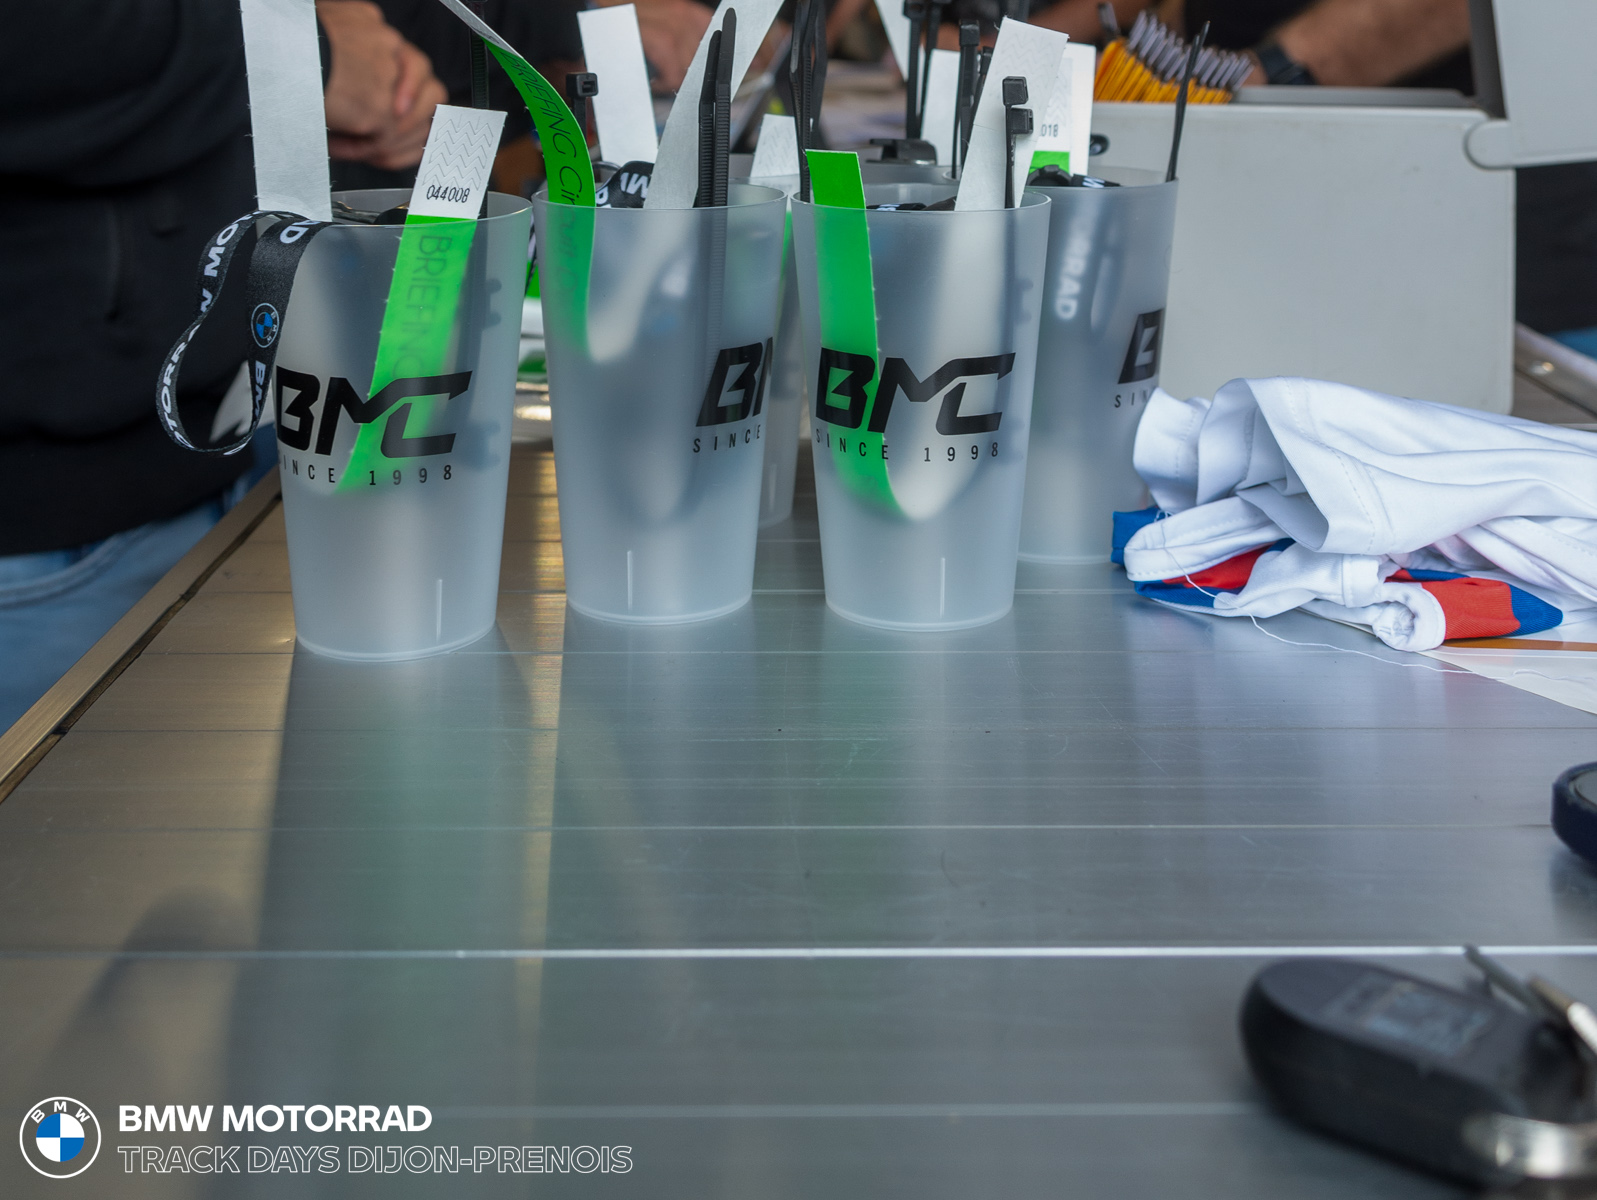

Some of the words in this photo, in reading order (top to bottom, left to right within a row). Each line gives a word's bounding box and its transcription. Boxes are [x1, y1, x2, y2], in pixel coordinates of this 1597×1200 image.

[500, 50, 577, 158] BRIEFING
[426, 184, 470, 203] 044008
[276, 365, 473, 459] BMC
[816, 347, 1016, 436] BMC
[280, 454, 336, 483] INCE
[369, 465, 452, 486] 1998
[816, 428, 889, 460] SINCE
[924, 442, 999, 462] 1998
